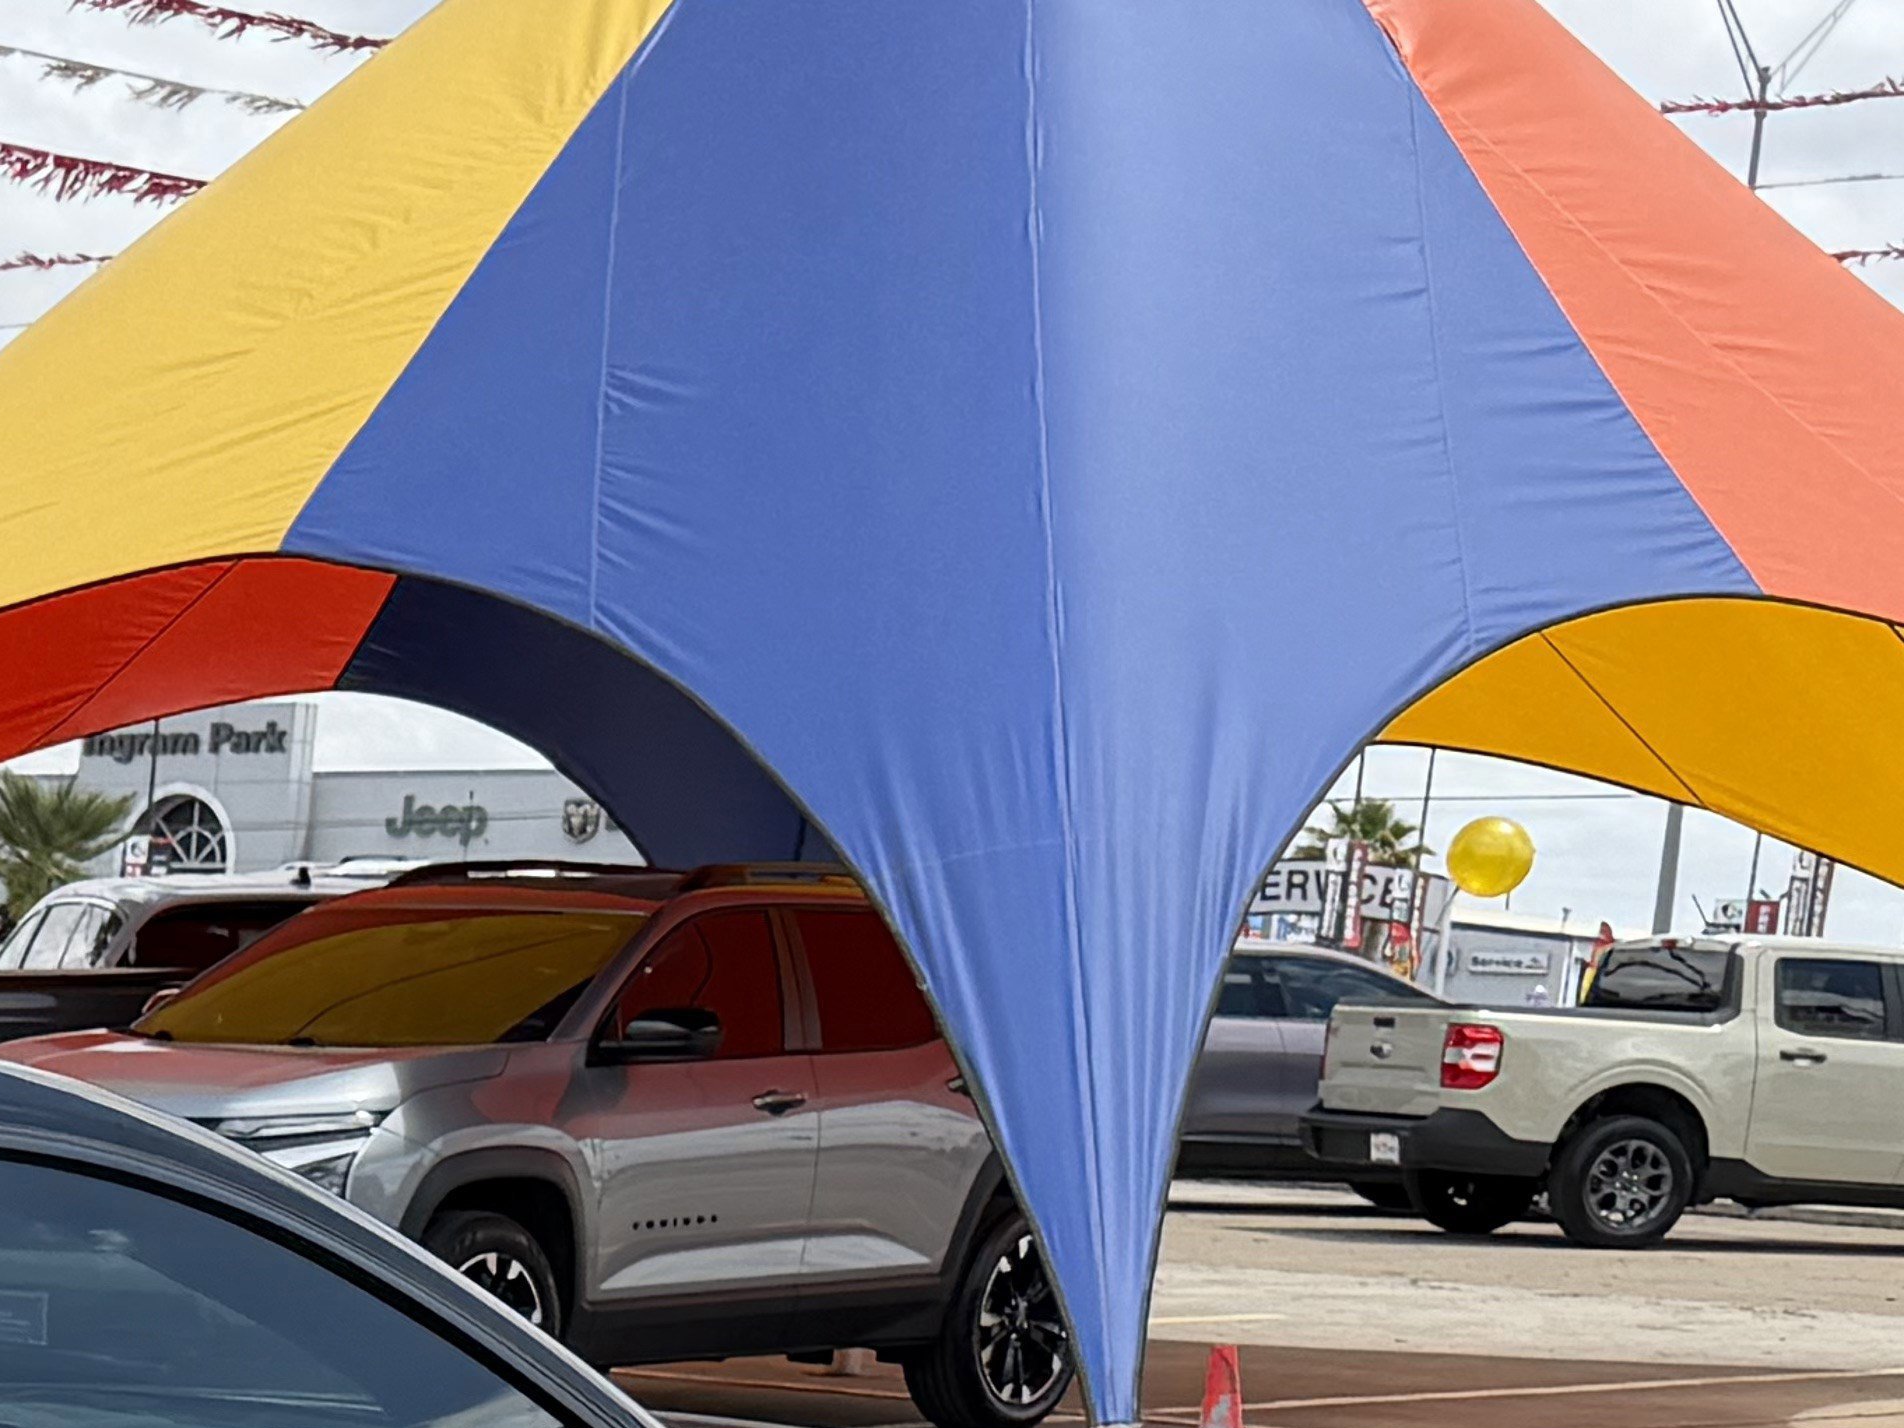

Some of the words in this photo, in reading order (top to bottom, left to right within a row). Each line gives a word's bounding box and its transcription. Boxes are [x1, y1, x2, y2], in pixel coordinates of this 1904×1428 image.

[208, 720, 287, 755] Park
[385, 794, 488, 847] Jeep
[1260, 869, 1396, 908] ERVCE
